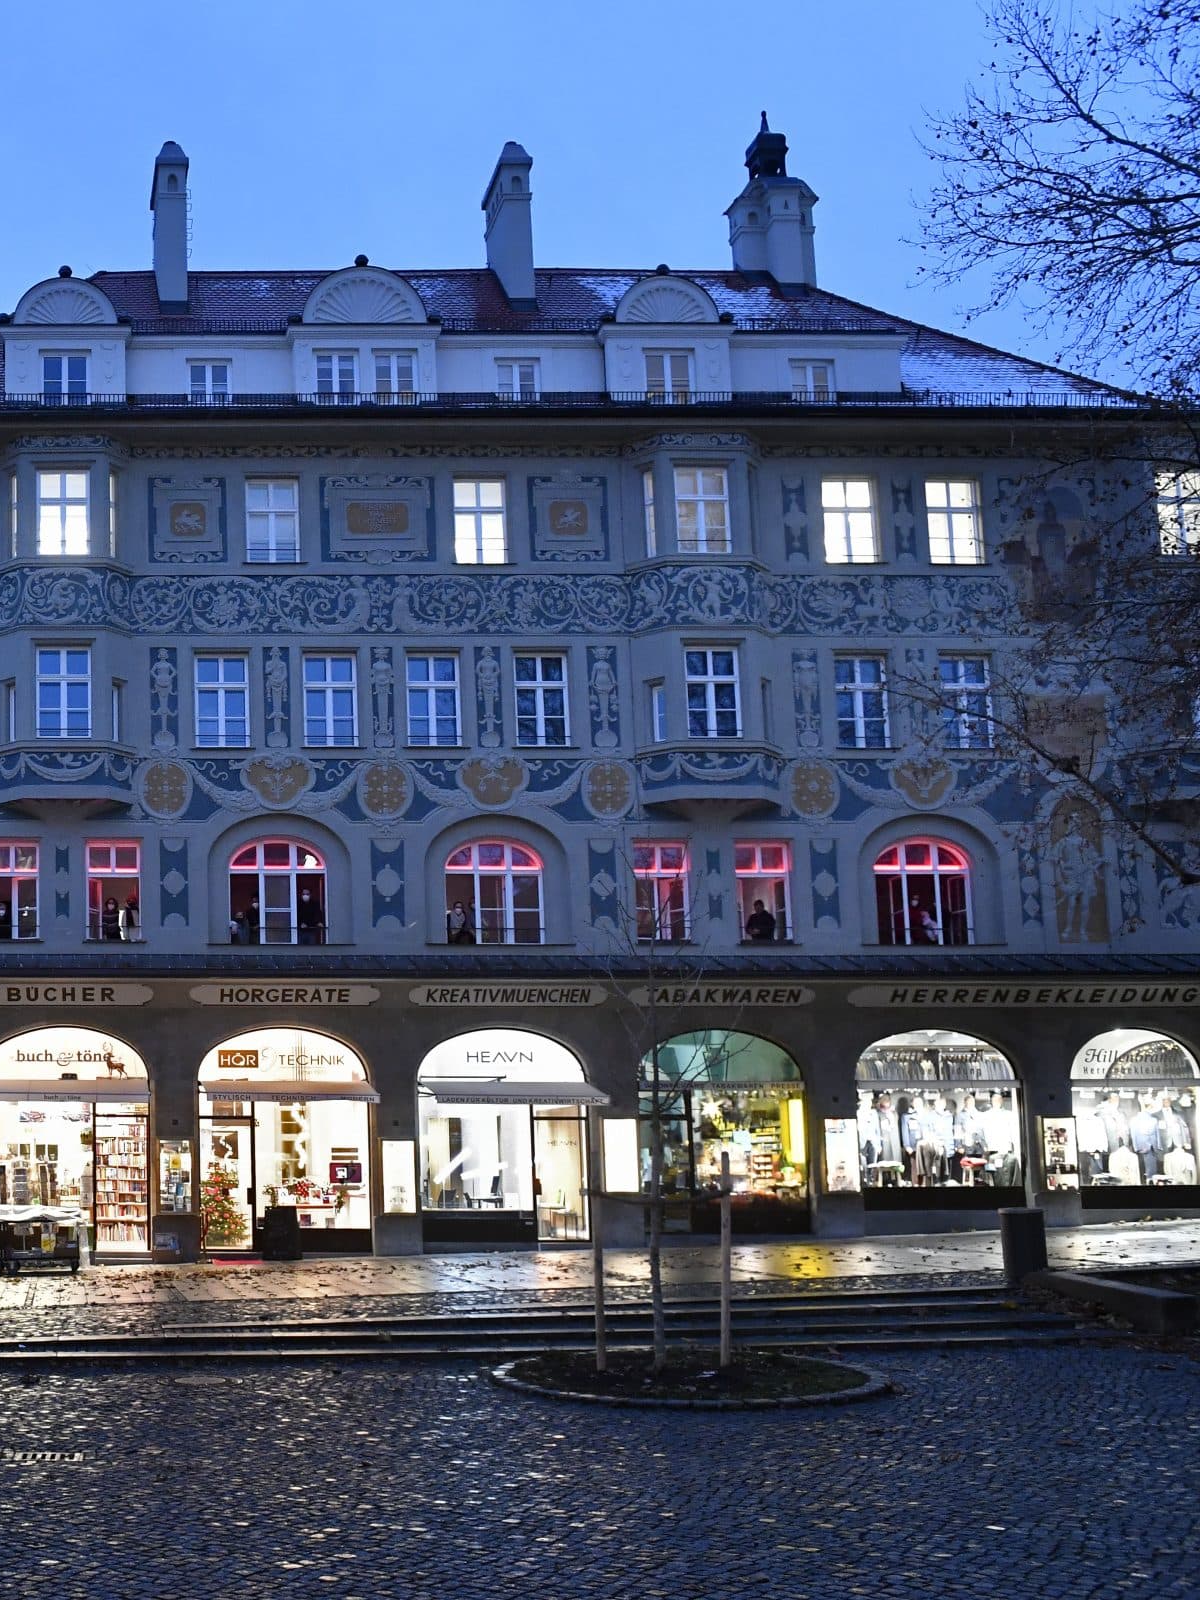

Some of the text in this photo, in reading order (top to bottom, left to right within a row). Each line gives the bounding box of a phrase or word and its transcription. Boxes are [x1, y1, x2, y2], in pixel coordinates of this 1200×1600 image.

[7, 986, 115, 1002] BÜCHER
[426, 988, 591, 1003] KREATIVMUENCHEN
[890, 987, 1198, 1003] HERRENBEKLEIDUNG
[16, 1049, 53, 1062] buch
[77, 1049, 109, 1062] töne
[278, 1054, 345, 1066] TECHNIK
